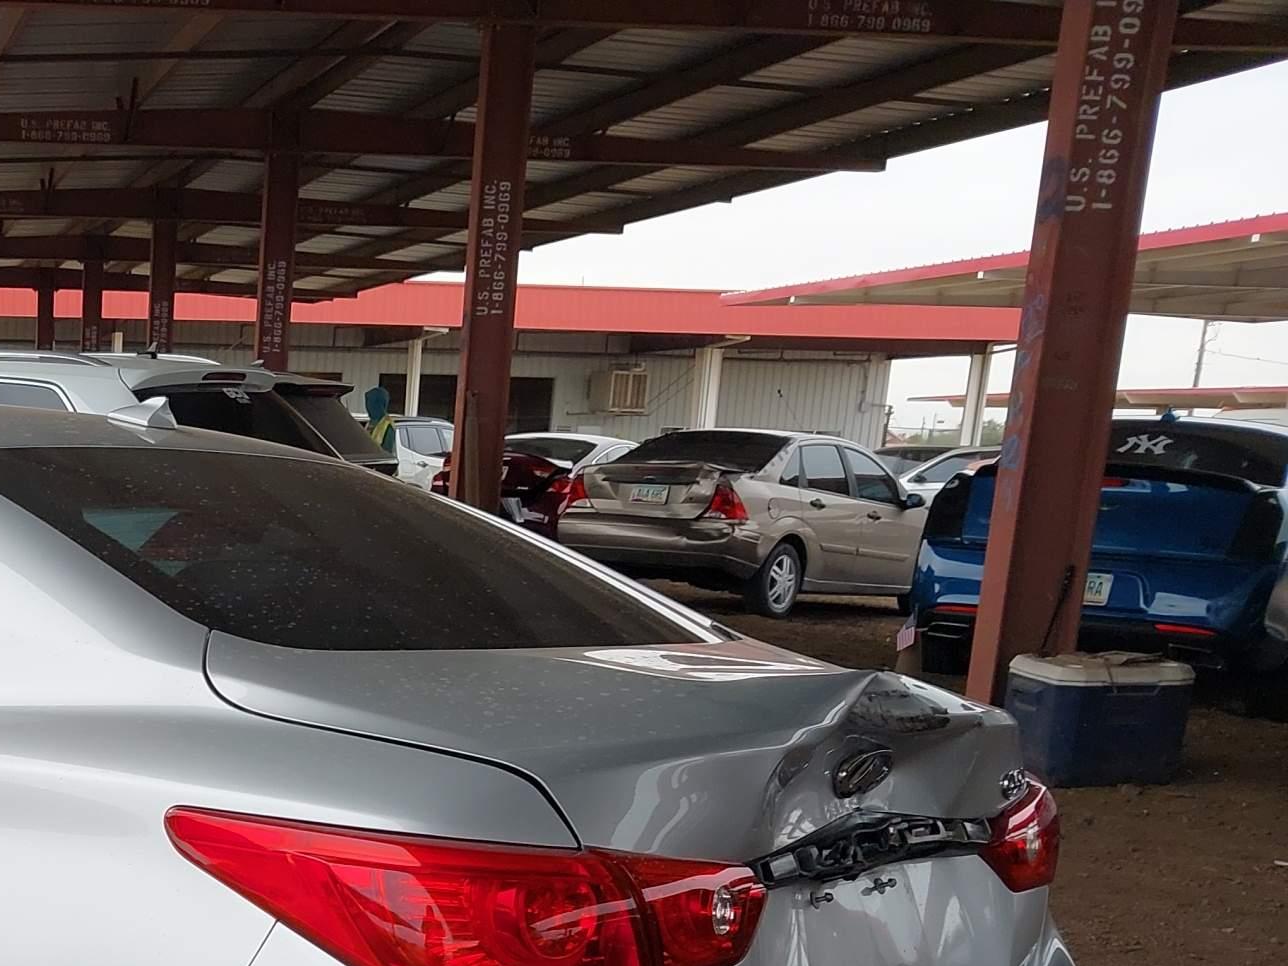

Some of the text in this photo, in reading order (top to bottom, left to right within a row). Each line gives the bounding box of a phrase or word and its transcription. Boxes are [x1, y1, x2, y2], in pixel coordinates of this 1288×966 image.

[1075, 24, 1112, 140] PREFAB
[1064, 158, 1093, 212] U.S.
[475, 180, 497, 316] U.S. PREFAB INC.
[490, 181, 512, 315] 1-866-799-0969
